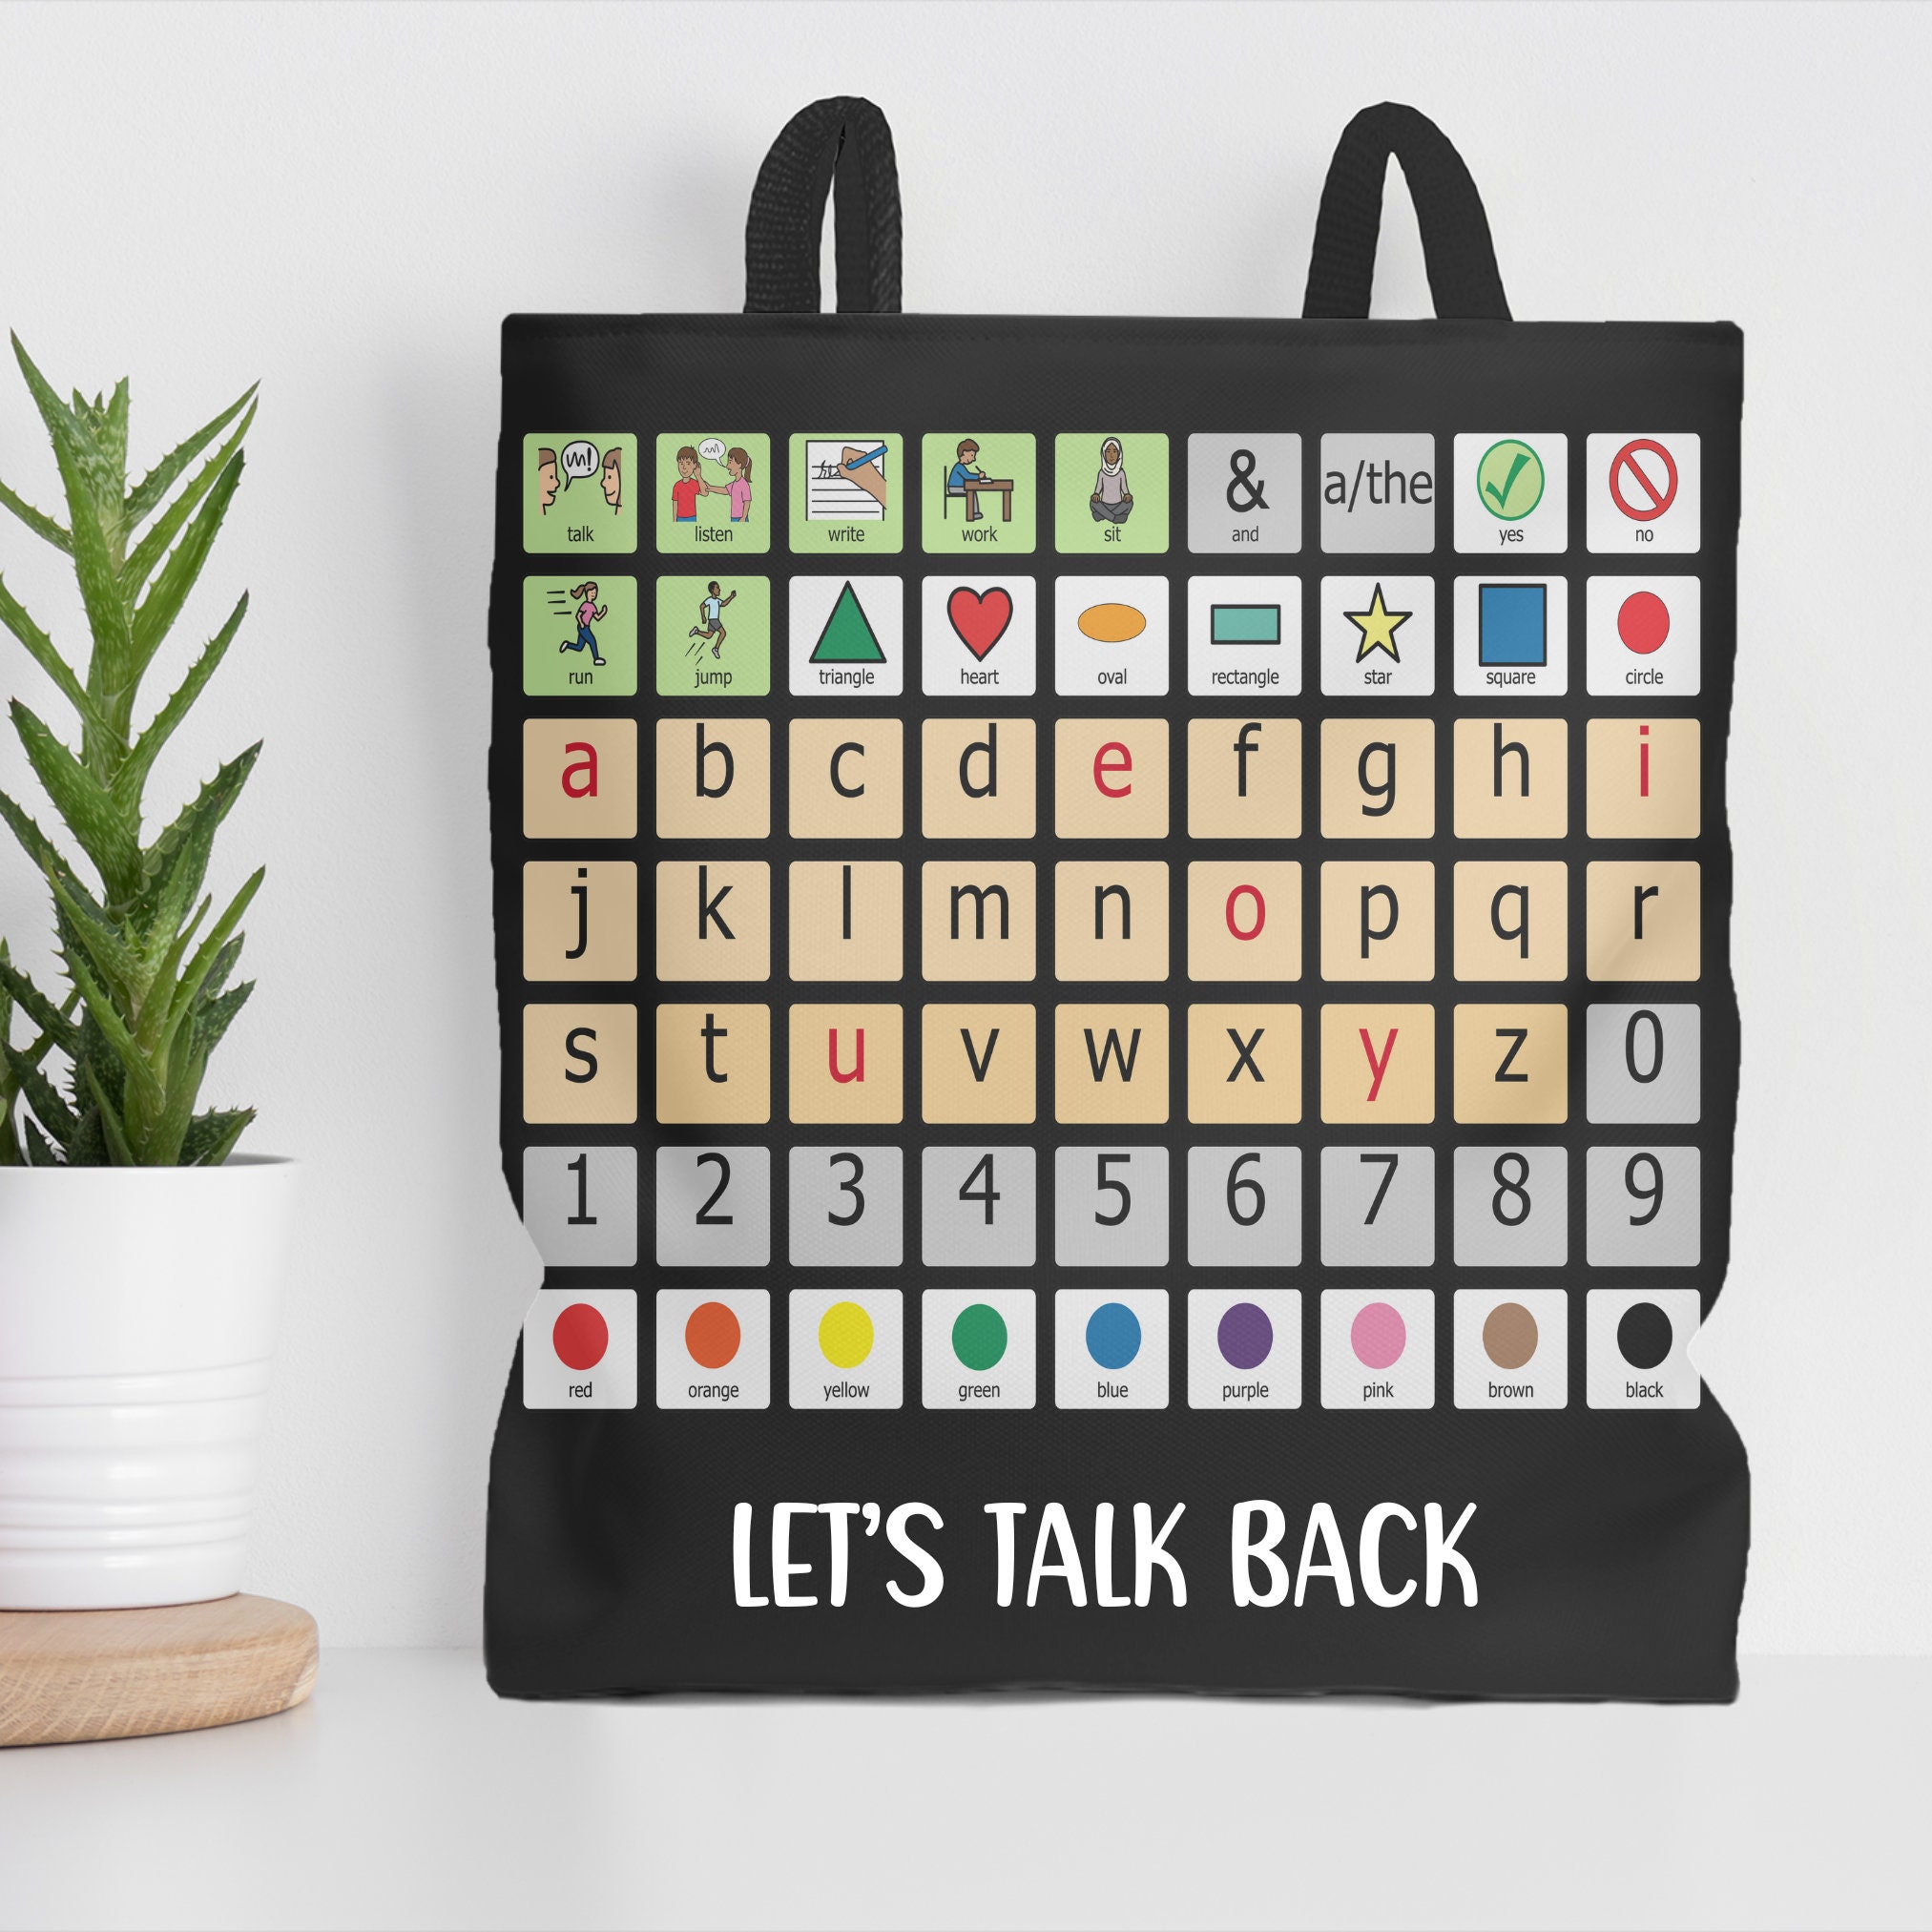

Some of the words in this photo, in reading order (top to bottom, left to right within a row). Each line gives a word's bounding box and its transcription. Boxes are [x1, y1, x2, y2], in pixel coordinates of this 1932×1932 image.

[1226, 448, 1271, 513] &
[1323, 459, 1433, 513] a/the
[567, 525, 594, 543] talk
[695, 525, 734, 543] listen
[827, 526, 865, 543] write
[961, 525, 999, 543] work
[1104, 524, 1122, 543] sit
[1232, 525, 1259, 543] and
[1498, 529, 1525, 547] yes
[1635, 529, 1654, 543] no
[569, 671, 593, 685] run
[694, 668, 733, 689] jump
[819, 667, 875, 689] triangle
[961, 667, 1000, 685] heart
[1097, 667, 1128, 685] oval
[1212, 667, 1279, 689] rectangle
[1363, 669, 1393, 685] star
[1485, 671, 1536, 689] square
[1625, 667, 1664, 685] circle
[561, 741, 598, 799] a
[696, 722, 735, 799] b
[829, 741, 865, 799] c
[959, 722, 998, 799] d
[1092, 741, 1132, 799] e
[1233, 721, 1262, 798] f
[1358, 741, 1397, 818] g
[1493, 722, 1530, 798] h
[1639, 724, 1650, 798] i
[565, 867, 588, 960] j
[698, 864, 737, 940] k
[950, 883, 1009, 940] m
[1094, 883, 1132, 940] n
[1225, 883, 1266, 942] o
[1361, 883, 1400, 960] p
[1490, 883, 1529, 960] q
[1633, 885, 1659, 940] r
[565, 1027, 598, 1084] s
[700, 1012, 728, 1084] t
[828, 1028, 865, 1084] u
[959, 1028, 1001, 1083] v
[1083, 1028, 1142, 1083] w
[1225, 1028, 1266, 1083] x
[1358, 1028, 1400, 1102] y
[1494, 1028, 1529, 1083] z
[1625, 1008, 1664, 1084] 0
[567, 1153, 597, 1225] 1
[696, 1152, 734, 1225] 2
[827, 1152, 865, 1227] 3
[958, 1153, 1001, 1225] 4
[1094, 1153, 1132, 1227] 5
[1226, 1152, 1266, 1227] 6
[1360, 1153, 1399, 1225] 7
[1491, 1152, 1531, 1227] 8
[1624, 1152, 1664, 1227] 9
[569, 1381, 592, 1399] red
[688, 1384, 739, 1402] orange
[822, 1381, 870, 1402] yellow
[958, 1384, 1001, 1402] green
[1097, 1381, 1129, 1399] blue
[1222, 1381, 1269, 1402] purple
[1362, 1381, 1395, 1402] pink
[1488, 1381, 1534, 1399] brown
[1626, 1381, 1665, 1399] black
[733, 1502, 945, 1609] LET'S
[984, 1502, 1188, 1608] TALK
[1231, 1499, 1479, 1609] BACK
